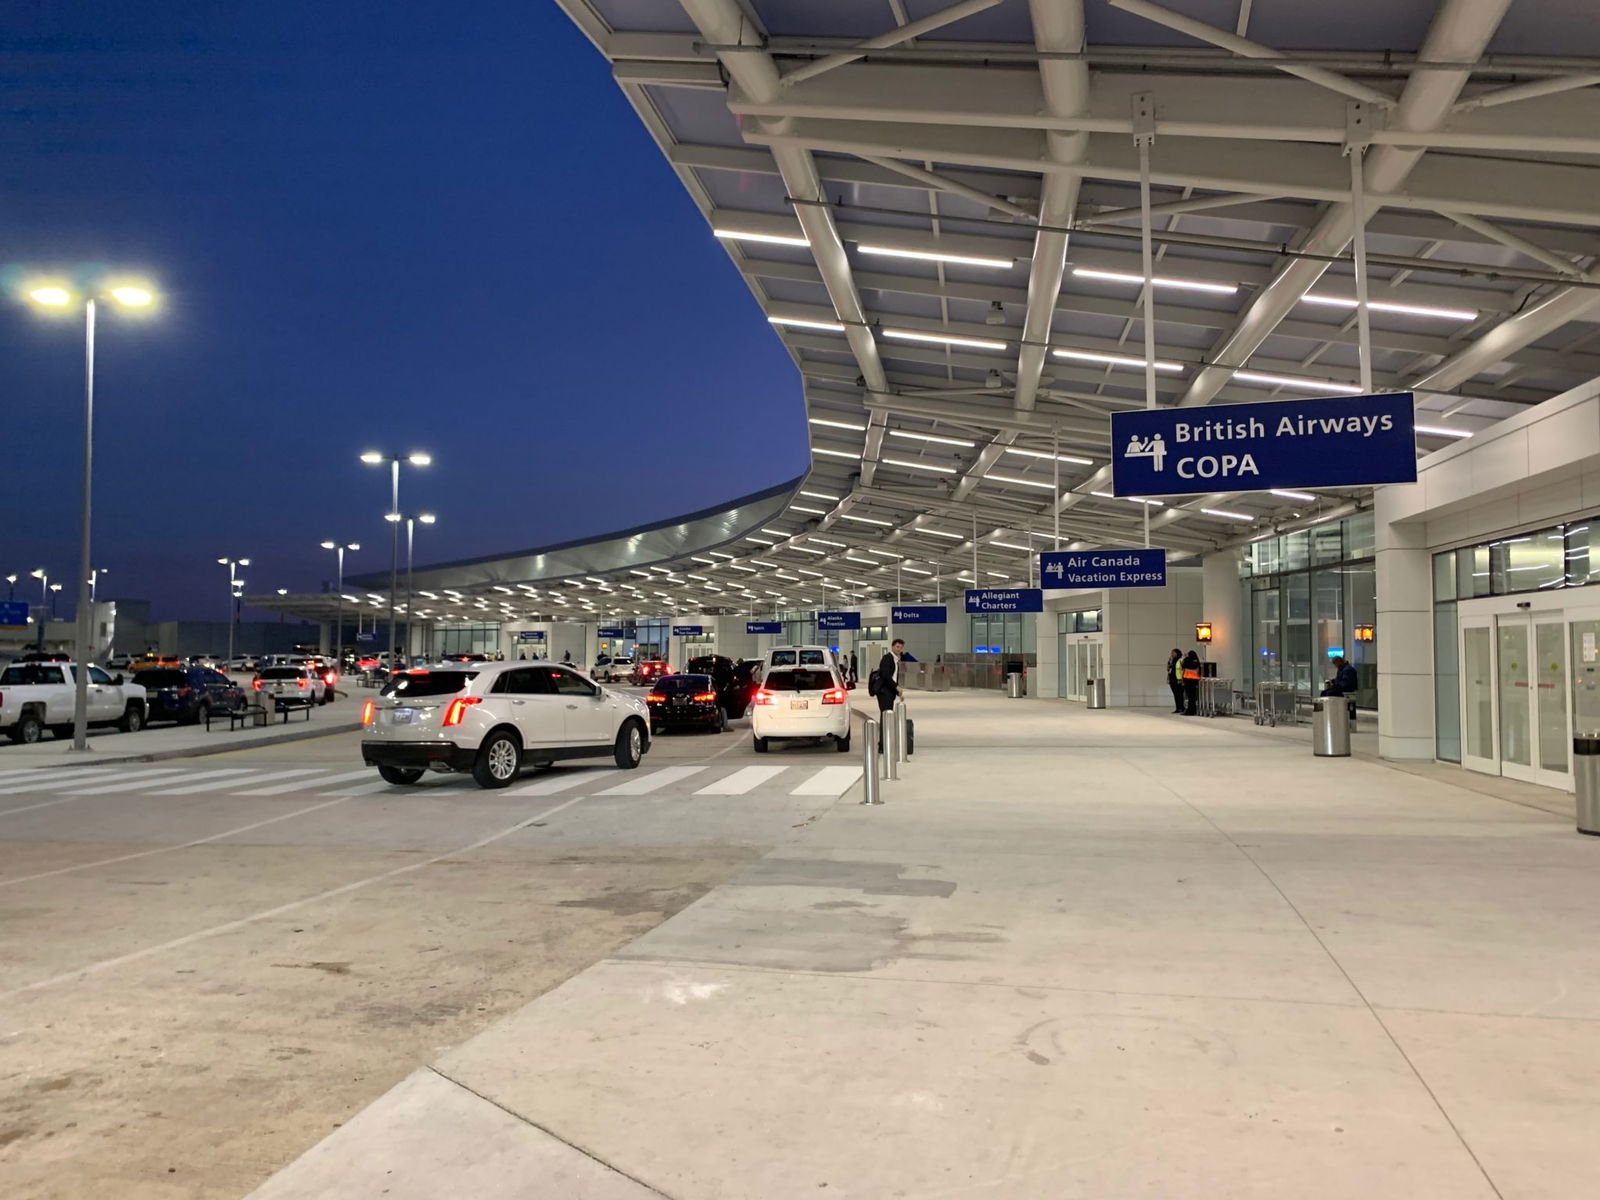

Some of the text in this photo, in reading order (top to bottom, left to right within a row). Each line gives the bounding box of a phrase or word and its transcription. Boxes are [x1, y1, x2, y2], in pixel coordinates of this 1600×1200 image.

[1175, 413, 1393, 443] British Airways
[1176, 453, 1259, 479] COPA
[1067, 555, 1140, 568] Air Canada
[1068, 572, 1162, 583] Vacation Express
[981, 592, 1020, 601] Allegiant
